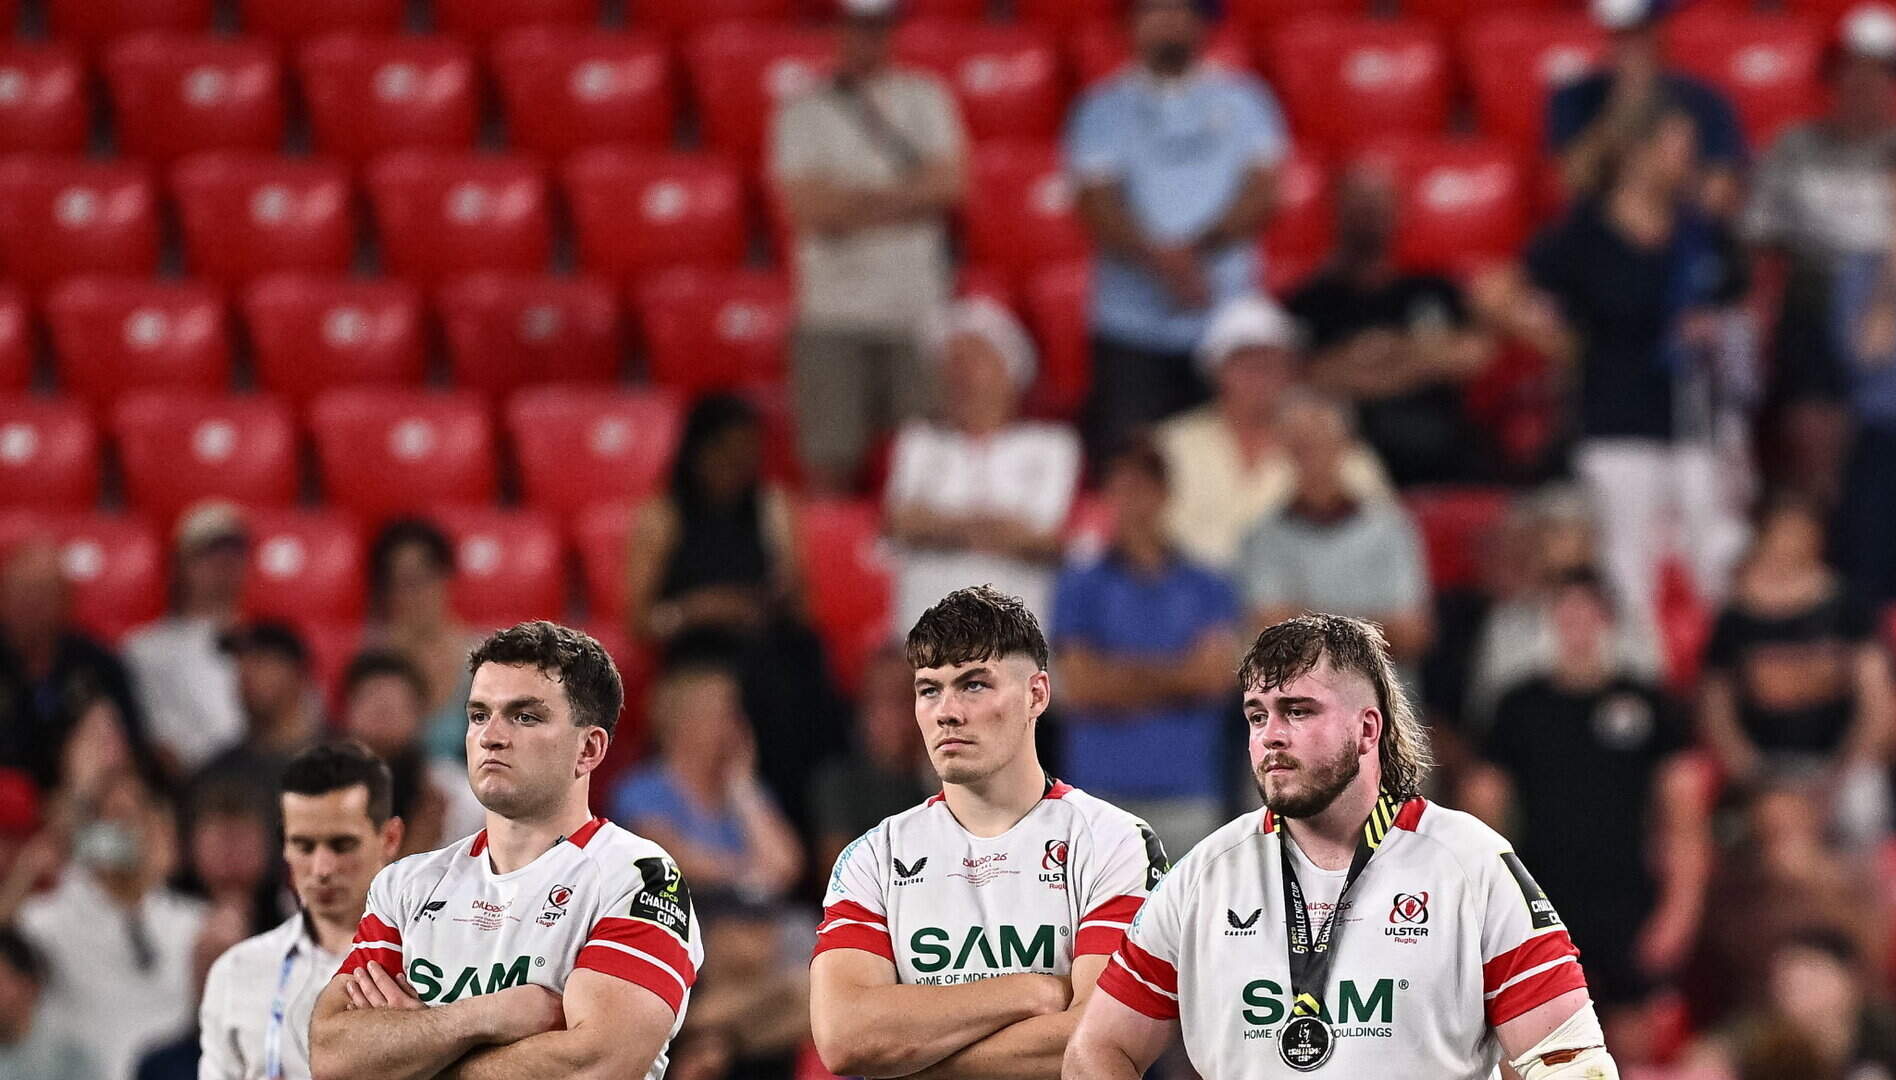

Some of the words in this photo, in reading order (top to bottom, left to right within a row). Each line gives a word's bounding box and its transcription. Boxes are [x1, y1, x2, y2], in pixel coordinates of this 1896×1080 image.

[1038, 873, 1067, 883] ULST
[640, 891, 687, 926] CHALLENGE
[657, 910, 676, 927] CUP
[1293, 898, 1308, 945] CHALLENGE
[1385, 927, 1429, 937] ULSTER
[945, 973, 960, 984] OF
[1243, 1029, 1273, 1040] HOME
[1333, 1027, 1393, 1038] OULDINGS
